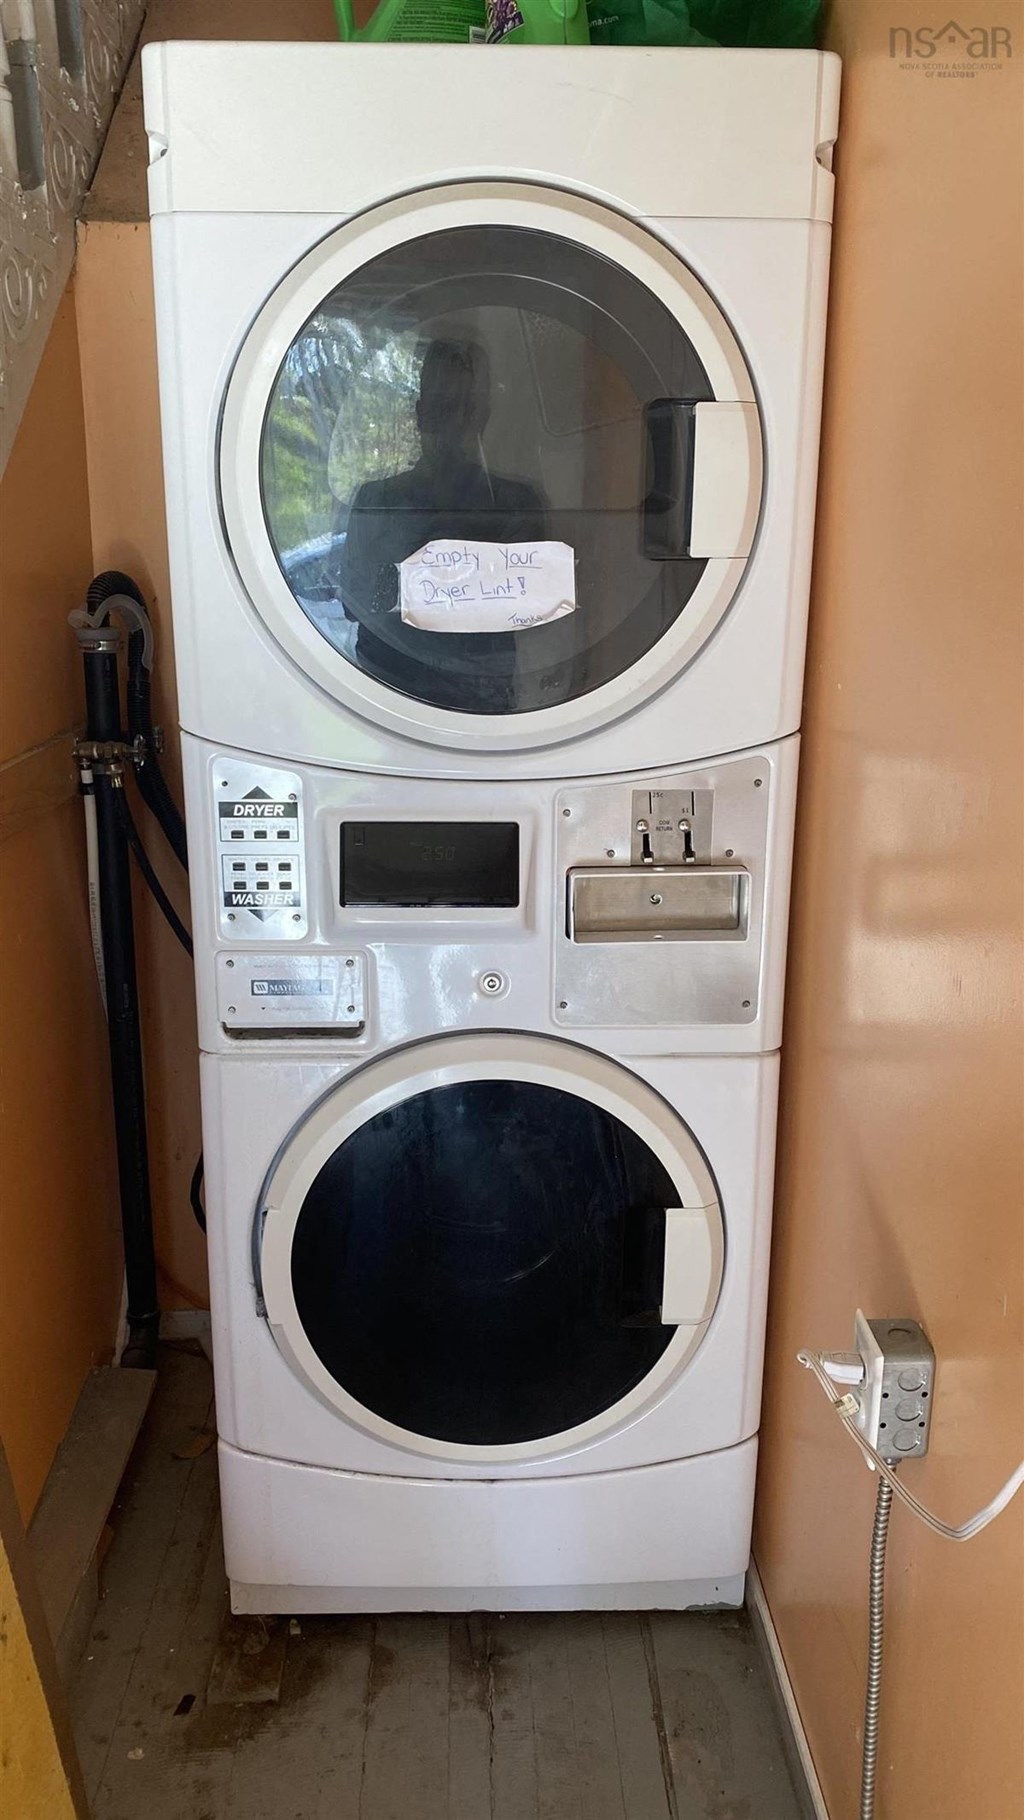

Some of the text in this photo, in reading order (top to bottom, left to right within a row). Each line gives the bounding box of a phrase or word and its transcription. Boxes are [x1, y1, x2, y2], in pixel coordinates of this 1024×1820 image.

[421, 546, 539, 570] Empty Your
[419, 580, 470, 606] Dryer
[233, 804, 284, 816] DRYER
[231, 893, 294, 905] WASHER
